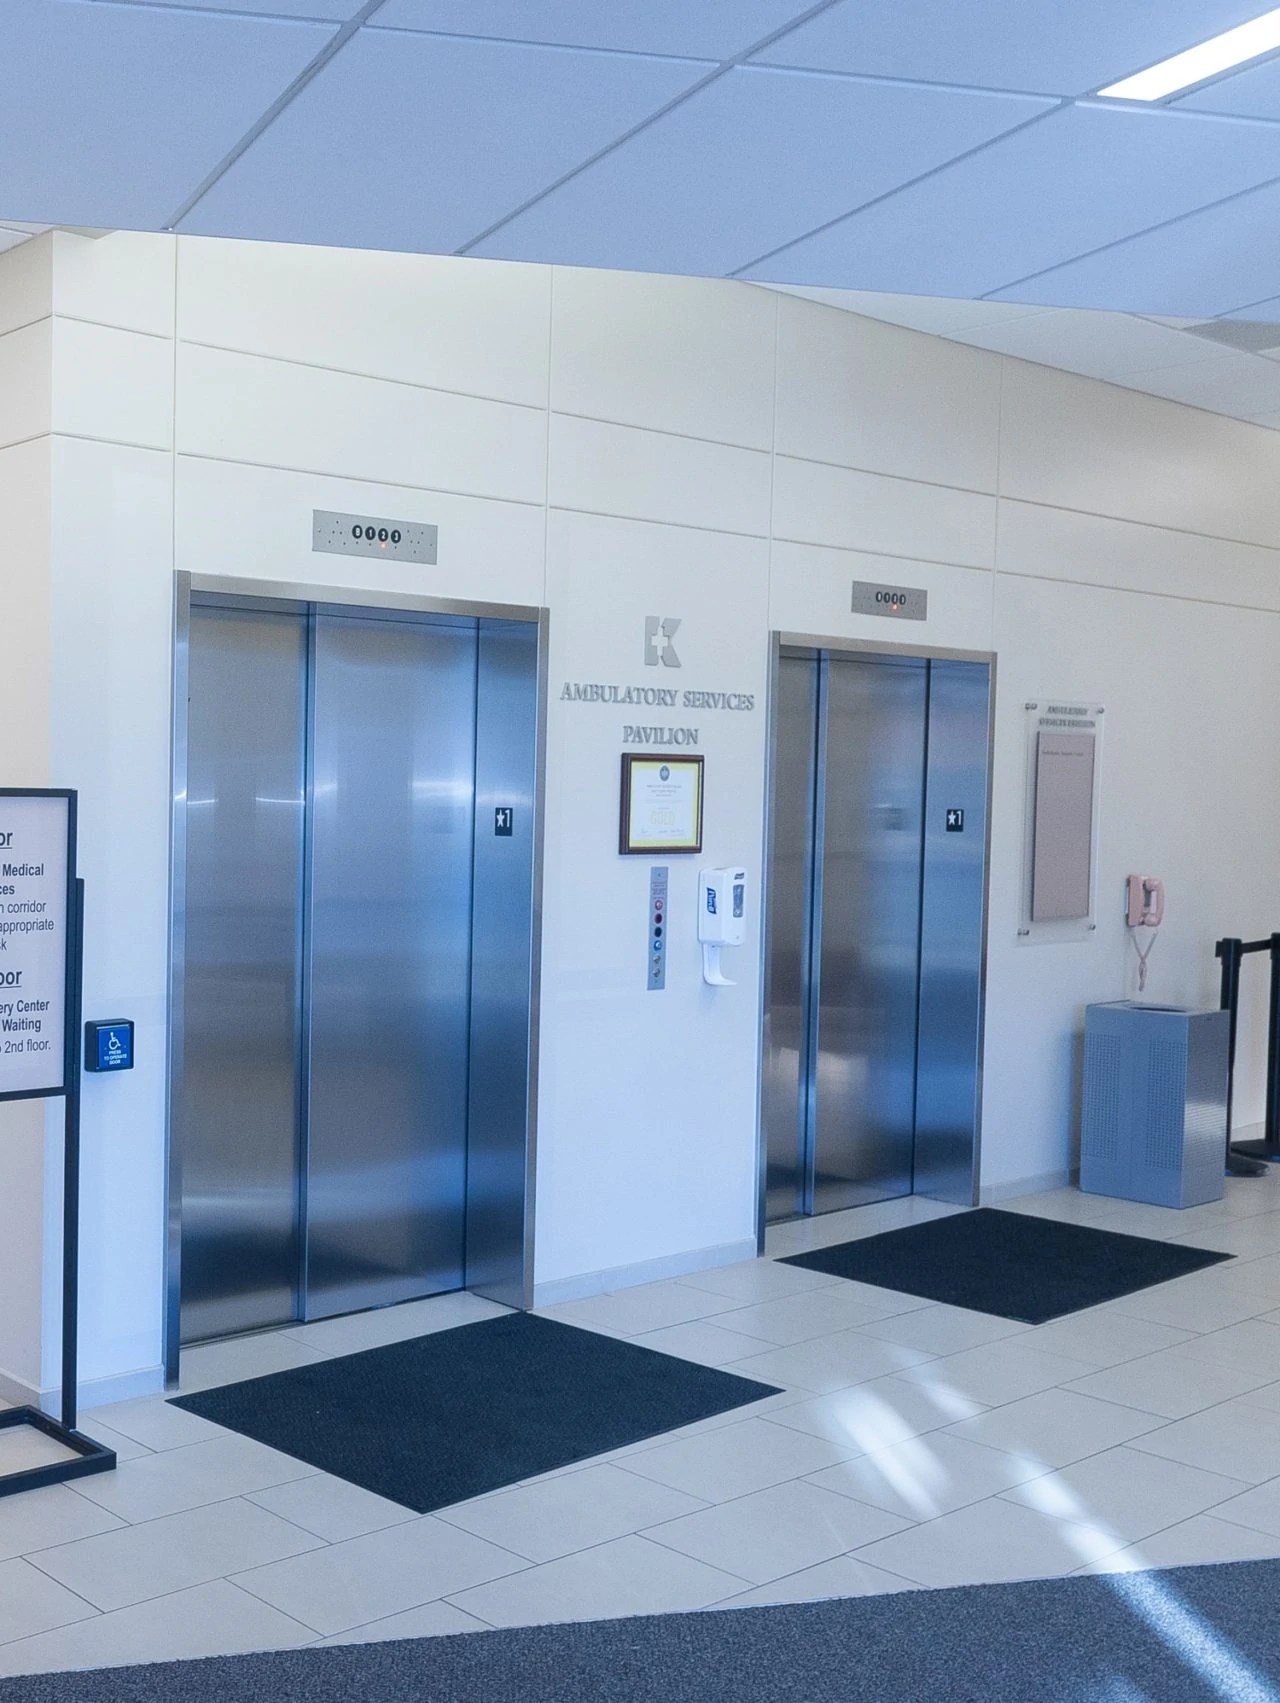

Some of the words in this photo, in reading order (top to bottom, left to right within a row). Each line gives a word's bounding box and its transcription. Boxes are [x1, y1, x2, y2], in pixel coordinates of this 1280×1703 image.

[560, 681, 680, 708] AMBULATORY
[683, 690, 755, 711] SERVICES
[622, 725, 699, 746] PAVILION
[2, 863, 44, 877] Medical
[7, 900, 47, 914] corridor
[16, 999, 50, 1013] Center
[1, 1017, 42, 1034] Waiting
[4, 1040, 24, 1054] 2nd
[26, 1037, 52, 1052] floor.
